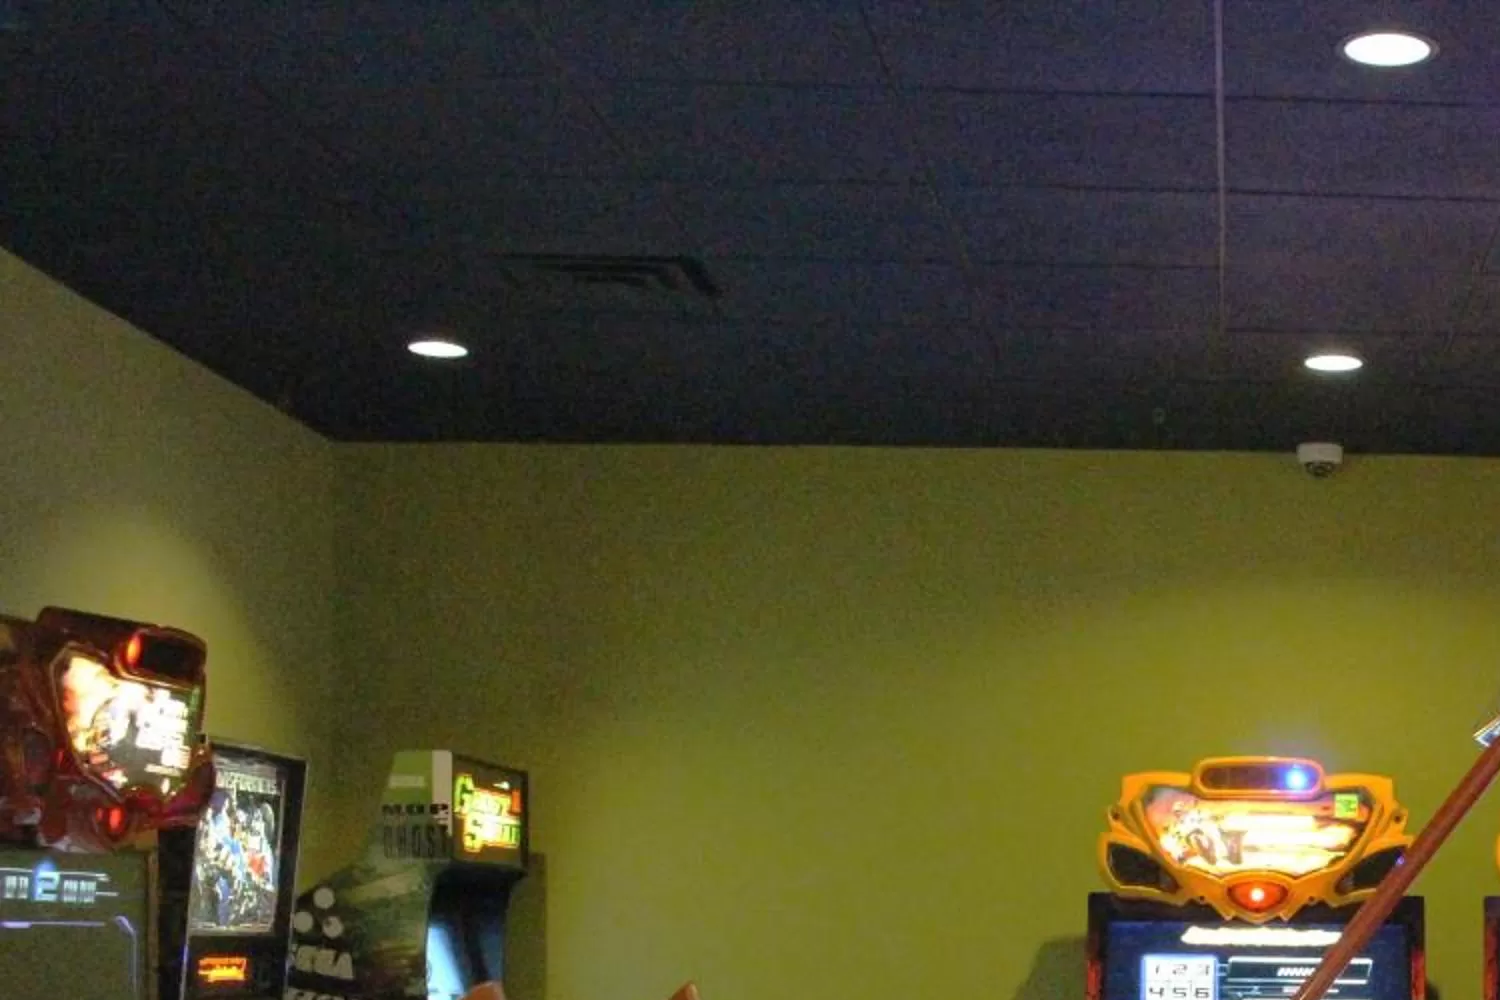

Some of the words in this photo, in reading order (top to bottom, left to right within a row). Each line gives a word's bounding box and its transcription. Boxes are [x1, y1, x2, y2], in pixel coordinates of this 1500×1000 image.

[1149, 987, 1164, 998] 4
[1172, 987, 1187, 998] 5
[1194, 987, 1209, 999] 6
